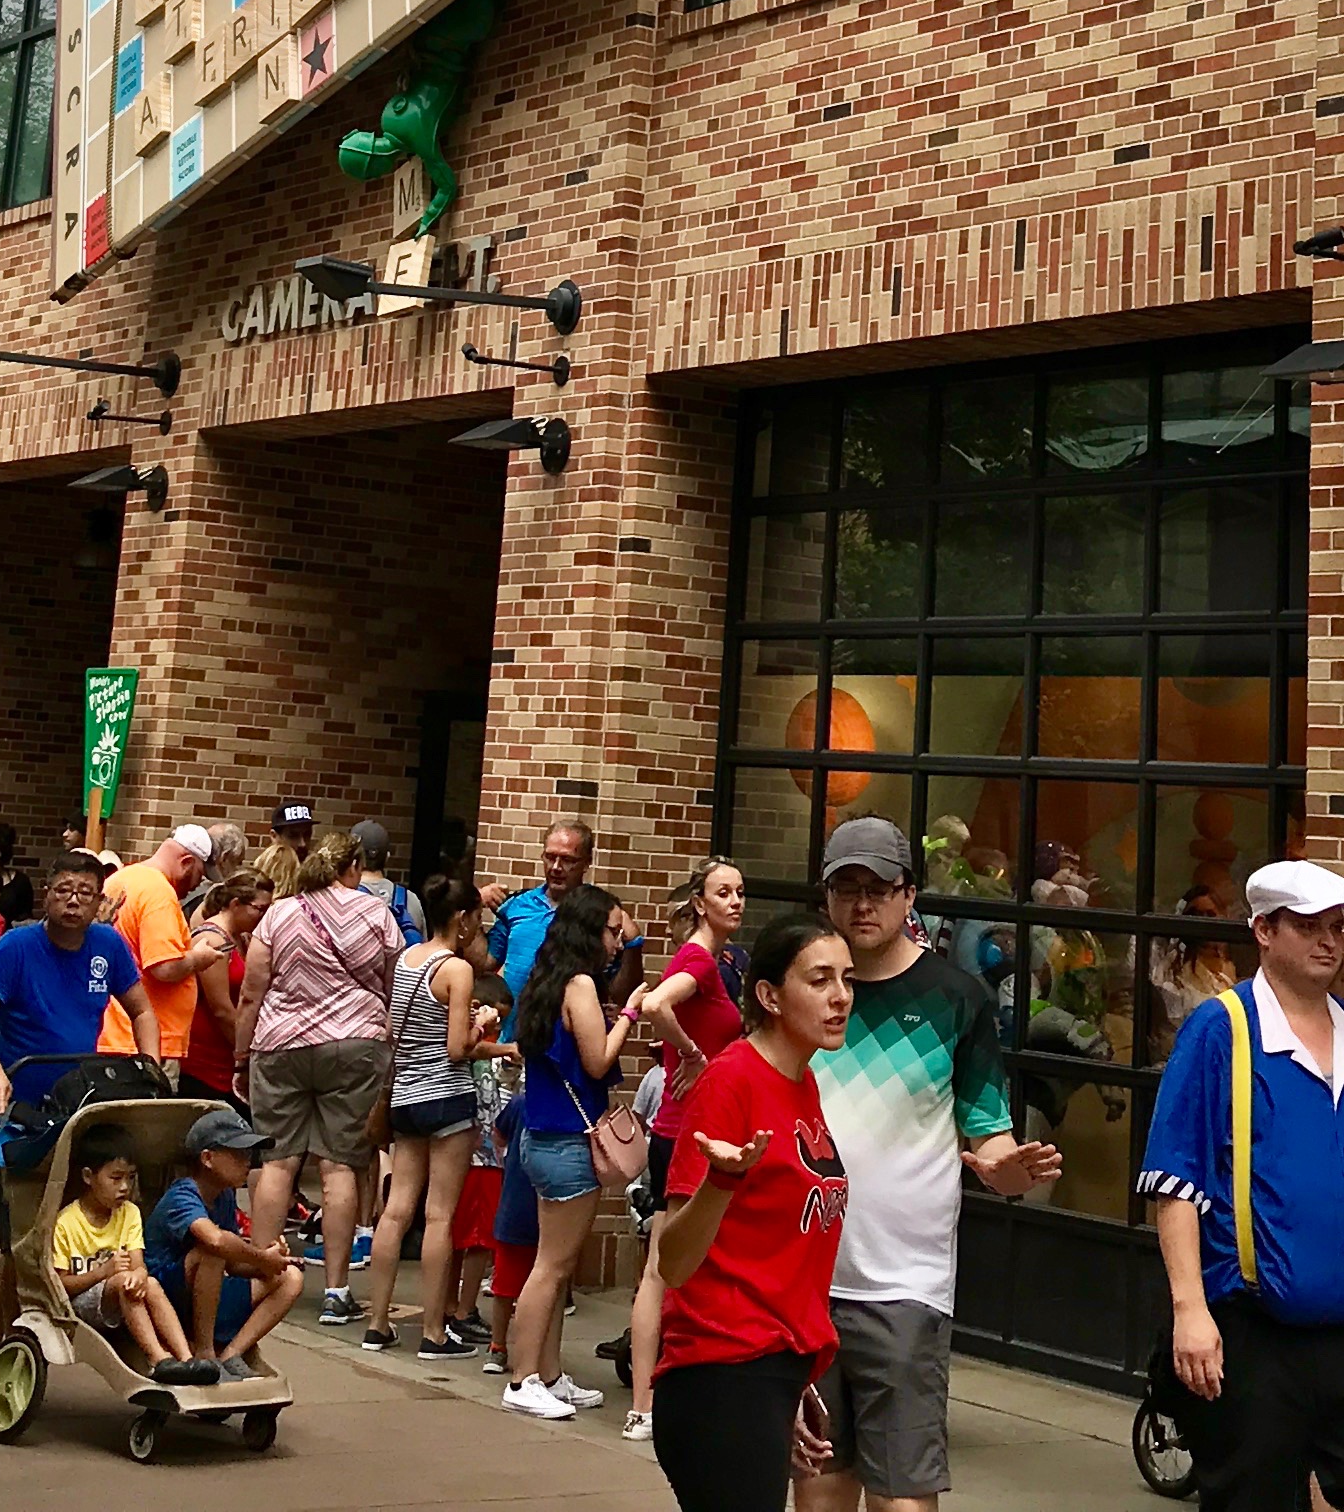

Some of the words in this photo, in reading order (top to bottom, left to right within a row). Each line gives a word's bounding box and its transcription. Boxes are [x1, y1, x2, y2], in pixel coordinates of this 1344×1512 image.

[140, 96, 154, 135] A
[177, 133, 197, 155] DOUBLE
[178, 149, 195, 167] LETTER
[178, 162, 195, 182] SCORE
